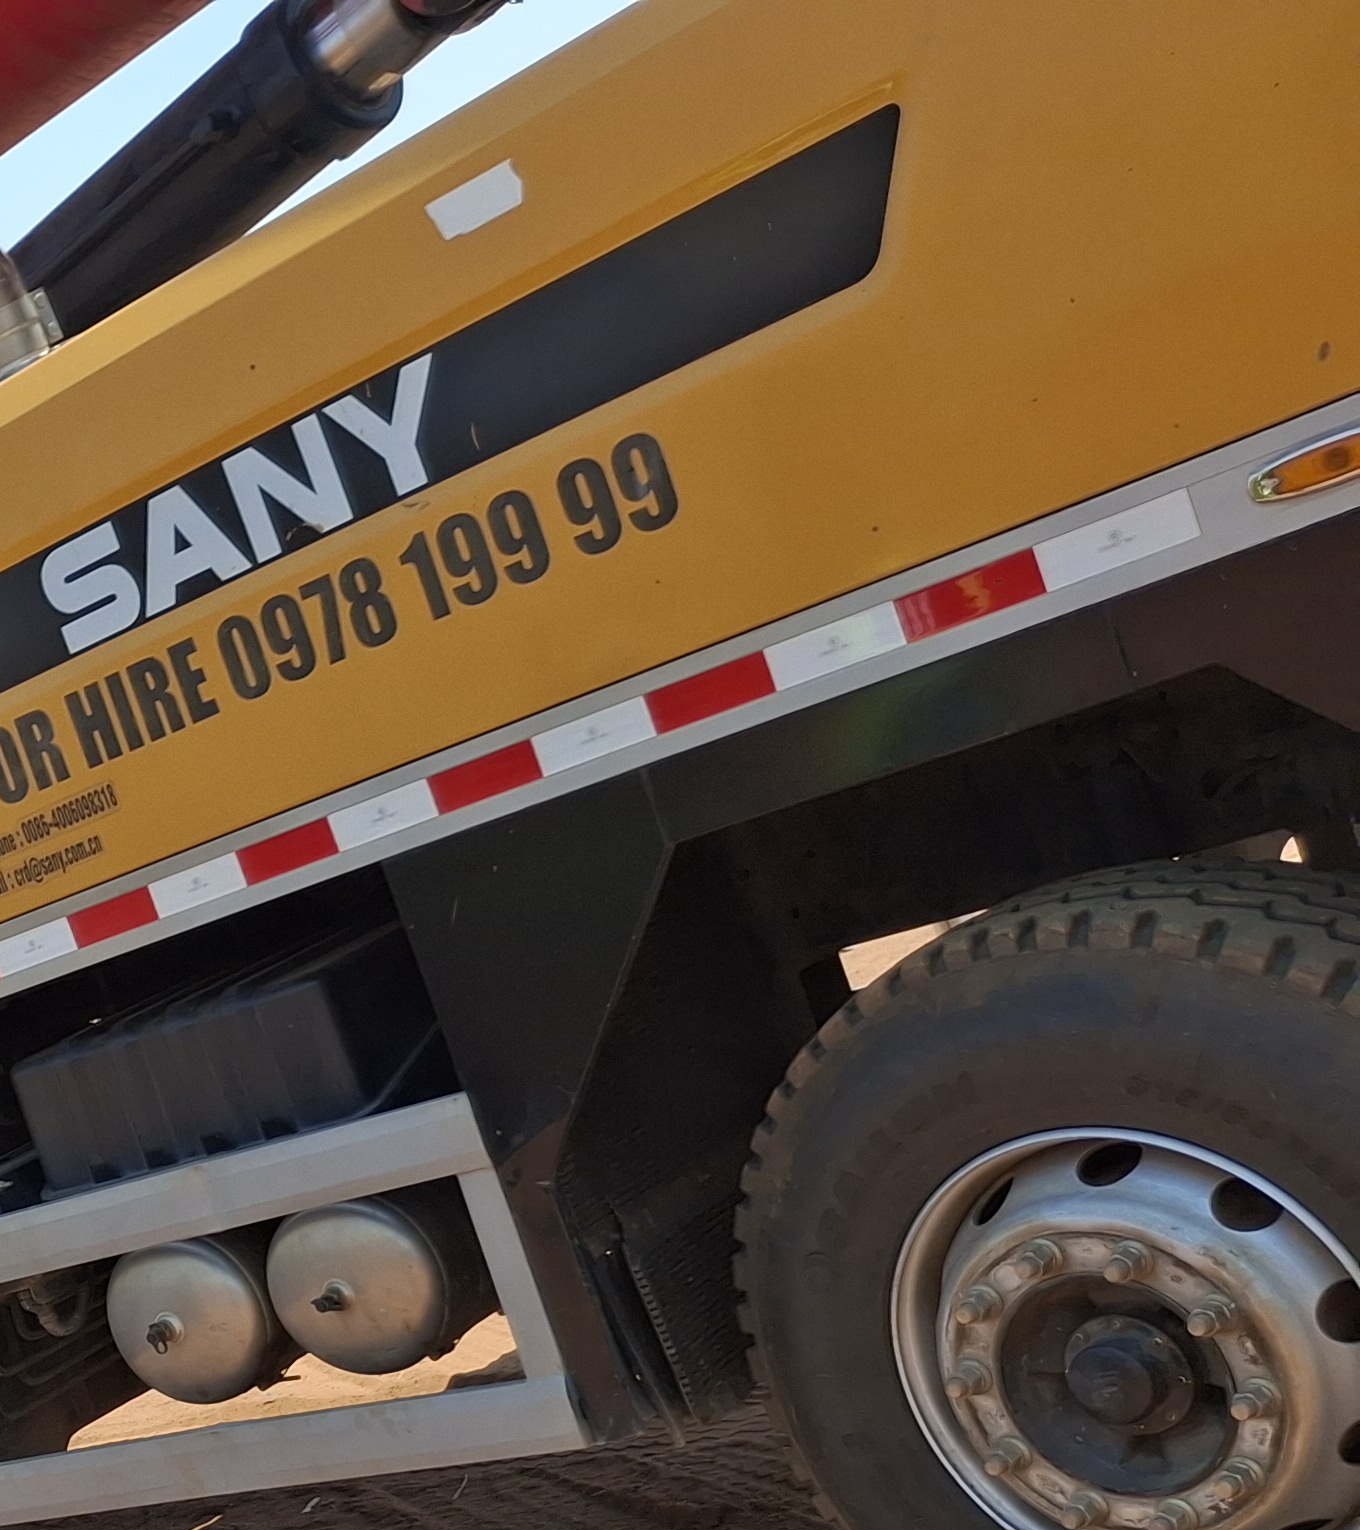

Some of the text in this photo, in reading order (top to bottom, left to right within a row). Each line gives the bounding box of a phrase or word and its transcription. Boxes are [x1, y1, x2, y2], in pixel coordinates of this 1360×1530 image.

[41, 352, 433, 654] SANY
[64, 636, 220, 769] HIRE
[216, 556, 397, 700] 0978
[399, 489, 550, 621] 199
[556, 432, 679, 556] 99
[14, 834, 103, 886] crd@sany.com.cn
[21, 783, 118, 845] 0086-4006098318
